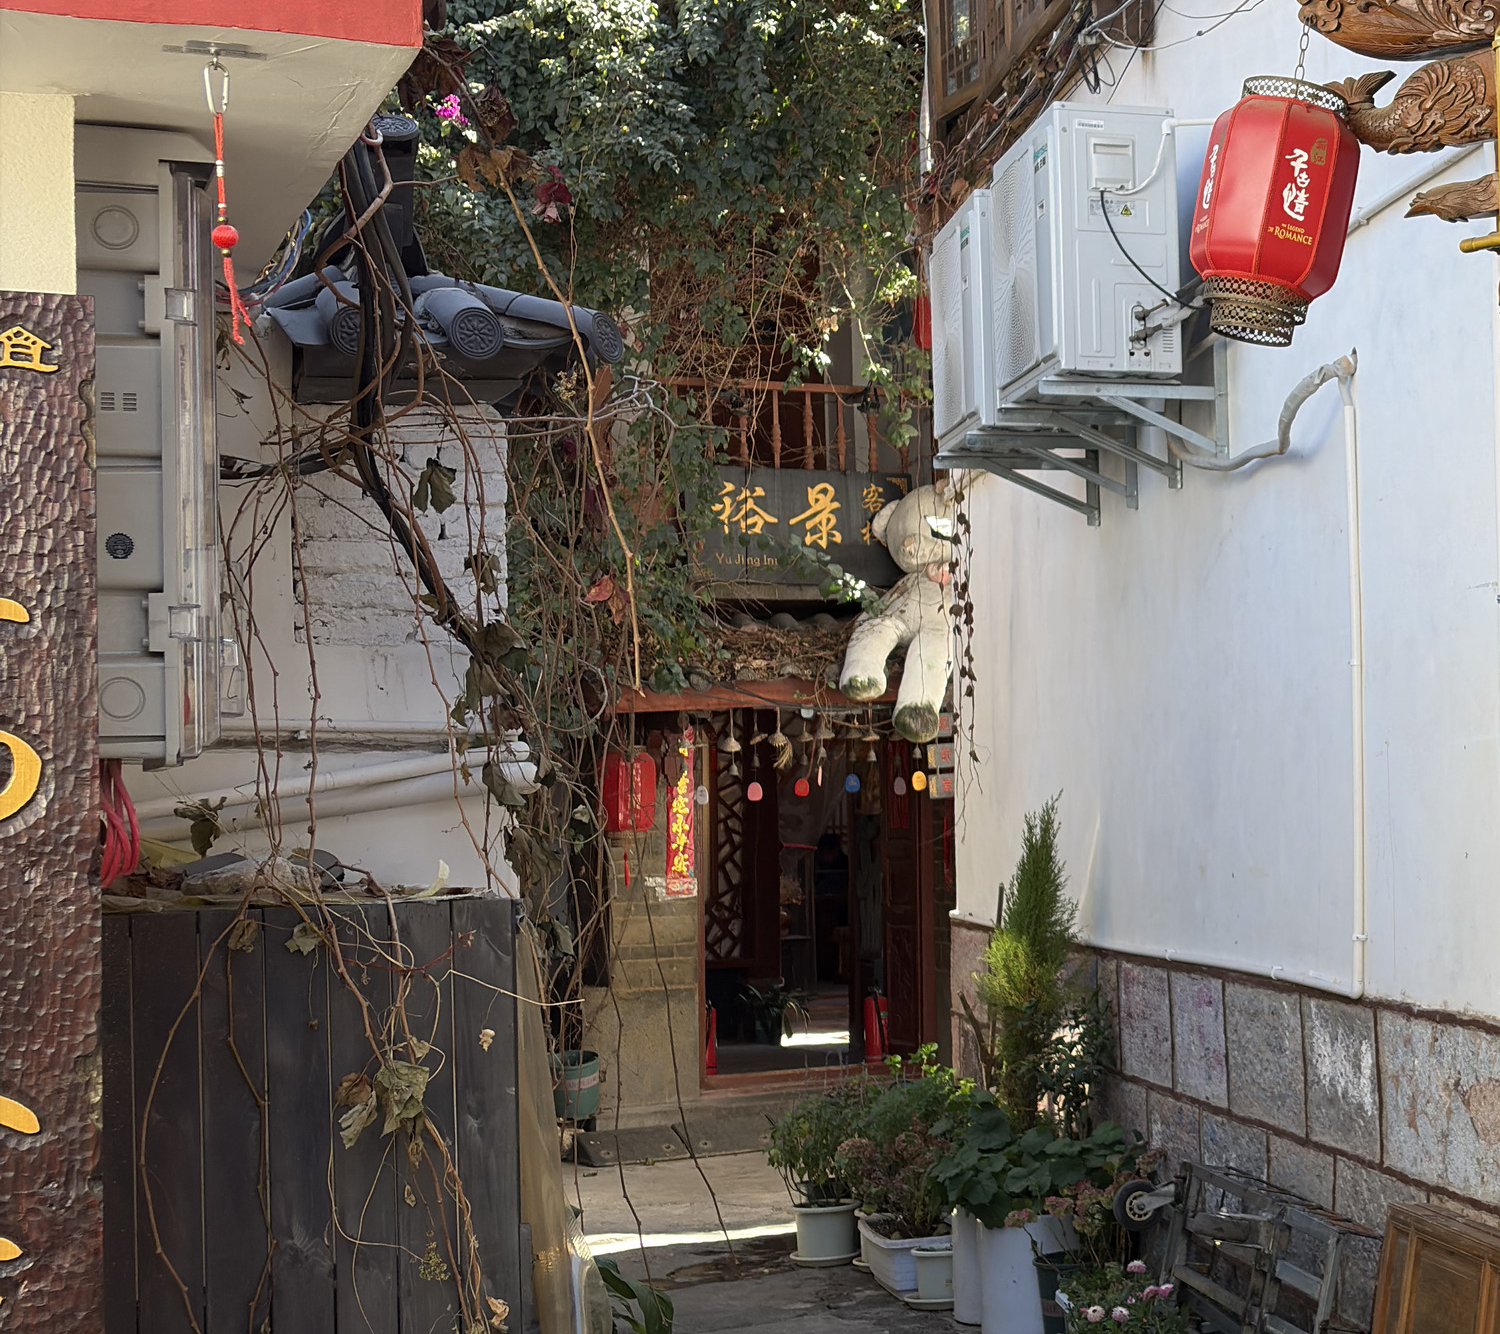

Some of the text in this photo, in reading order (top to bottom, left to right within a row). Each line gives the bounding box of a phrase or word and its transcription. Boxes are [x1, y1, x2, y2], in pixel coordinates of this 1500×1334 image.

[1274, 225, 1313, 245] ROMANCE
[710, 481, 843, 550] 裕景
[715, 553, 733, 565] Yu
[735, 553, 761, 567] Jing
